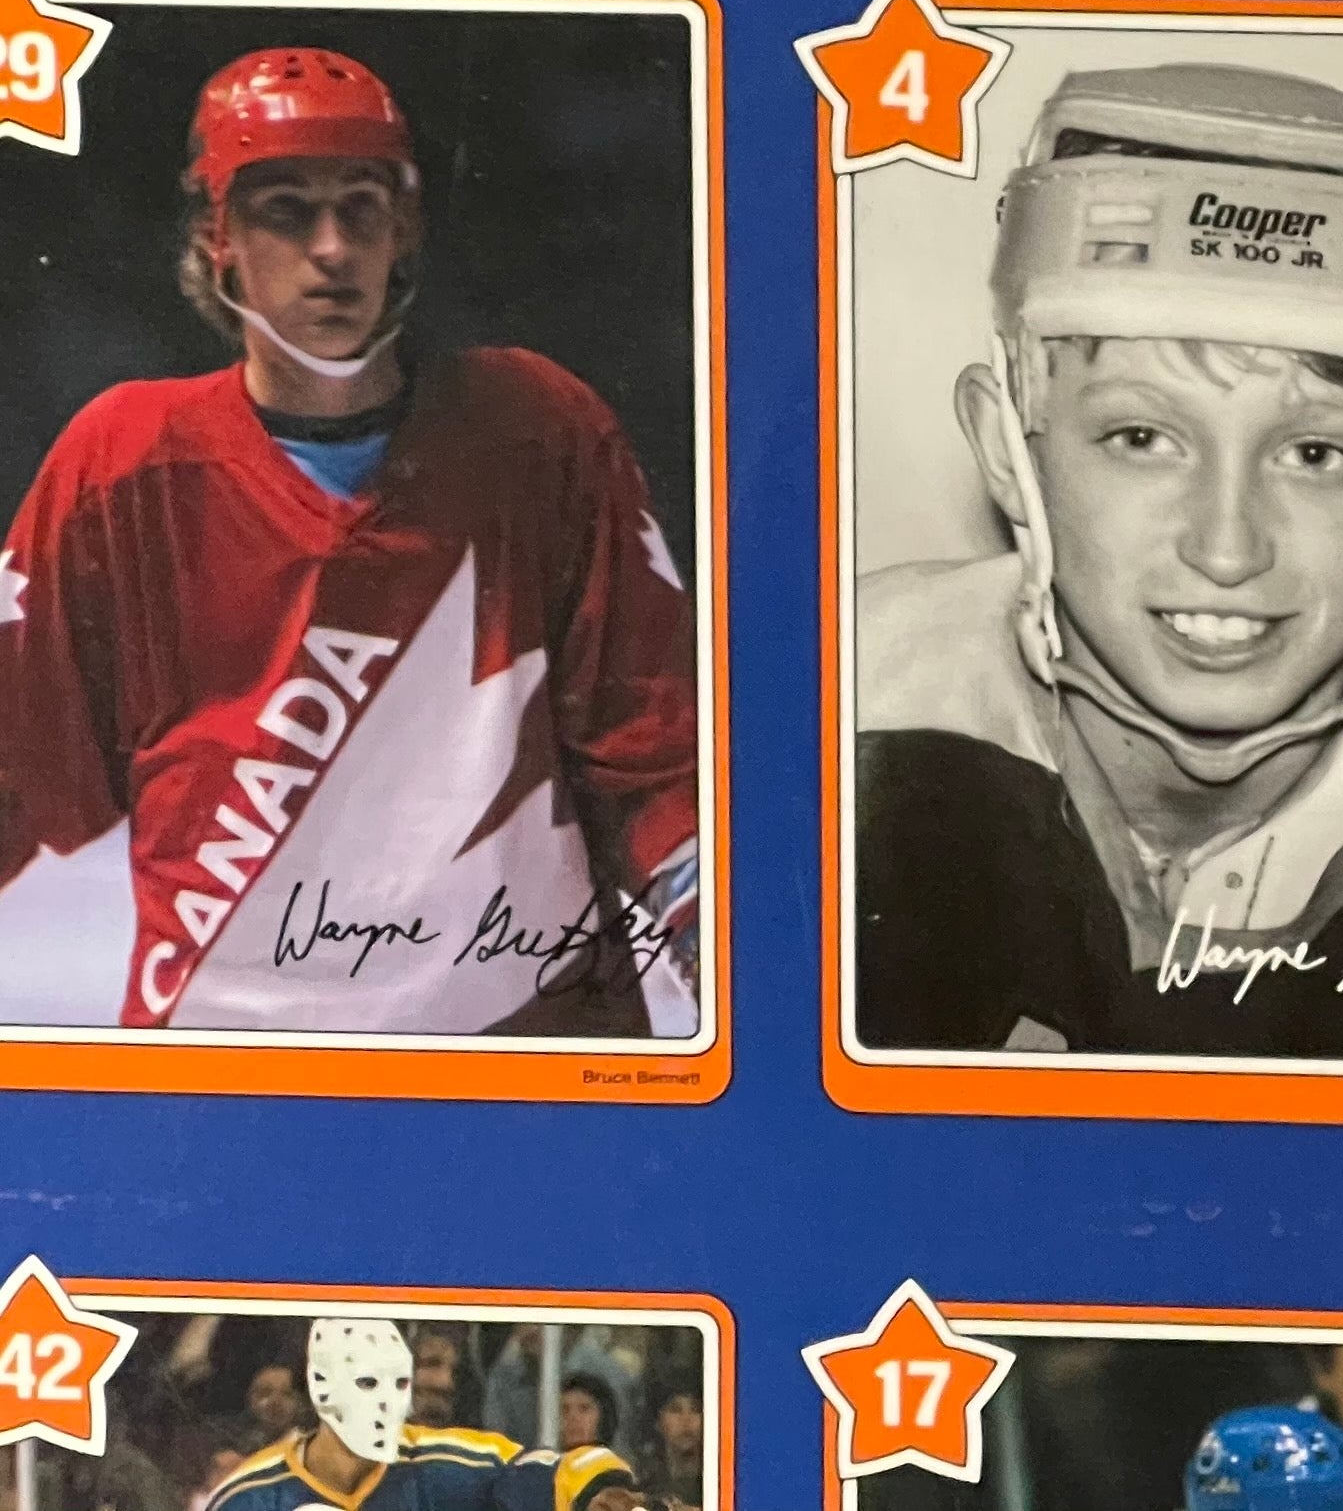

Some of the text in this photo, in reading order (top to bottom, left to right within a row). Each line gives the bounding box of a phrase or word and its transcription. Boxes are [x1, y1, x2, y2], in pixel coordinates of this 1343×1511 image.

[0, 31, 56, 101] 9
[878, 49, 930, 123] 4
[1189, 192, 1327, 240] Cooper
[1191, 239, 1222, 258] SK
[1233, 243, 1280, 264] 100
[141, 625, 400, 1014] CANADA
[274, 880, 440, 978] Wayne
[1157, 907, 1327, 1004] Wayne
[583, 1070, 700, 1085] Bruce Bennett
[0, 1333, 82, 1402] 42
[873, 1359, 952, 1428] 17
